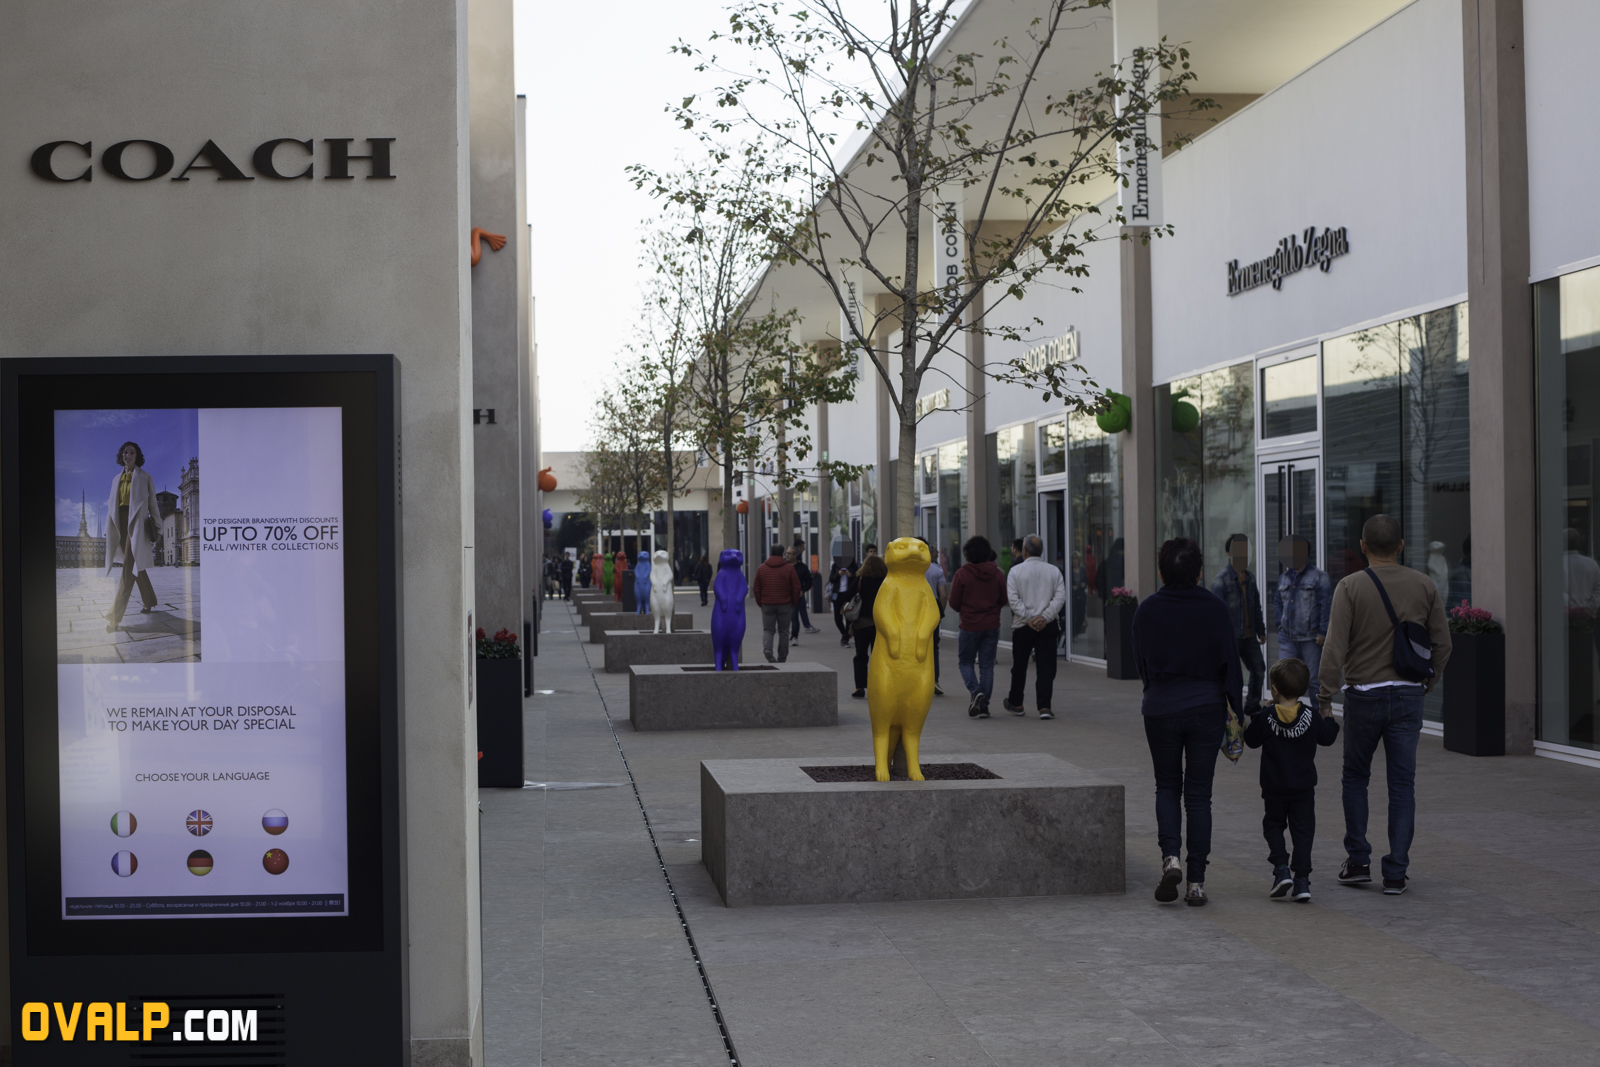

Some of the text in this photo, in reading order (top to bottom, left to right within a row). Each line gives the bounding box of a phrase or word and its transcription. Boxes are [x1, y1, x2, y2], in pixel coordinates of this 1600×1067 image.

[31, 137, 396, 182] COACH
[1225, 225, 1350, 297] Ermenegildo Zegna
[848, 281, 857, 336] BOTHERS
[203, 525, 339, 542] UP TO 70% OFF
[271, 542, 339, 551] COLLECTIONS
[106, 705, 297, 718] WE REMAIN AT YOUR DISPOSAL
[108, 718, 296, 732] TO MAKE YOUR DAY SPECIAL
[135, 771, 270, 782] CHOOSE YOUR LANGUAGE
